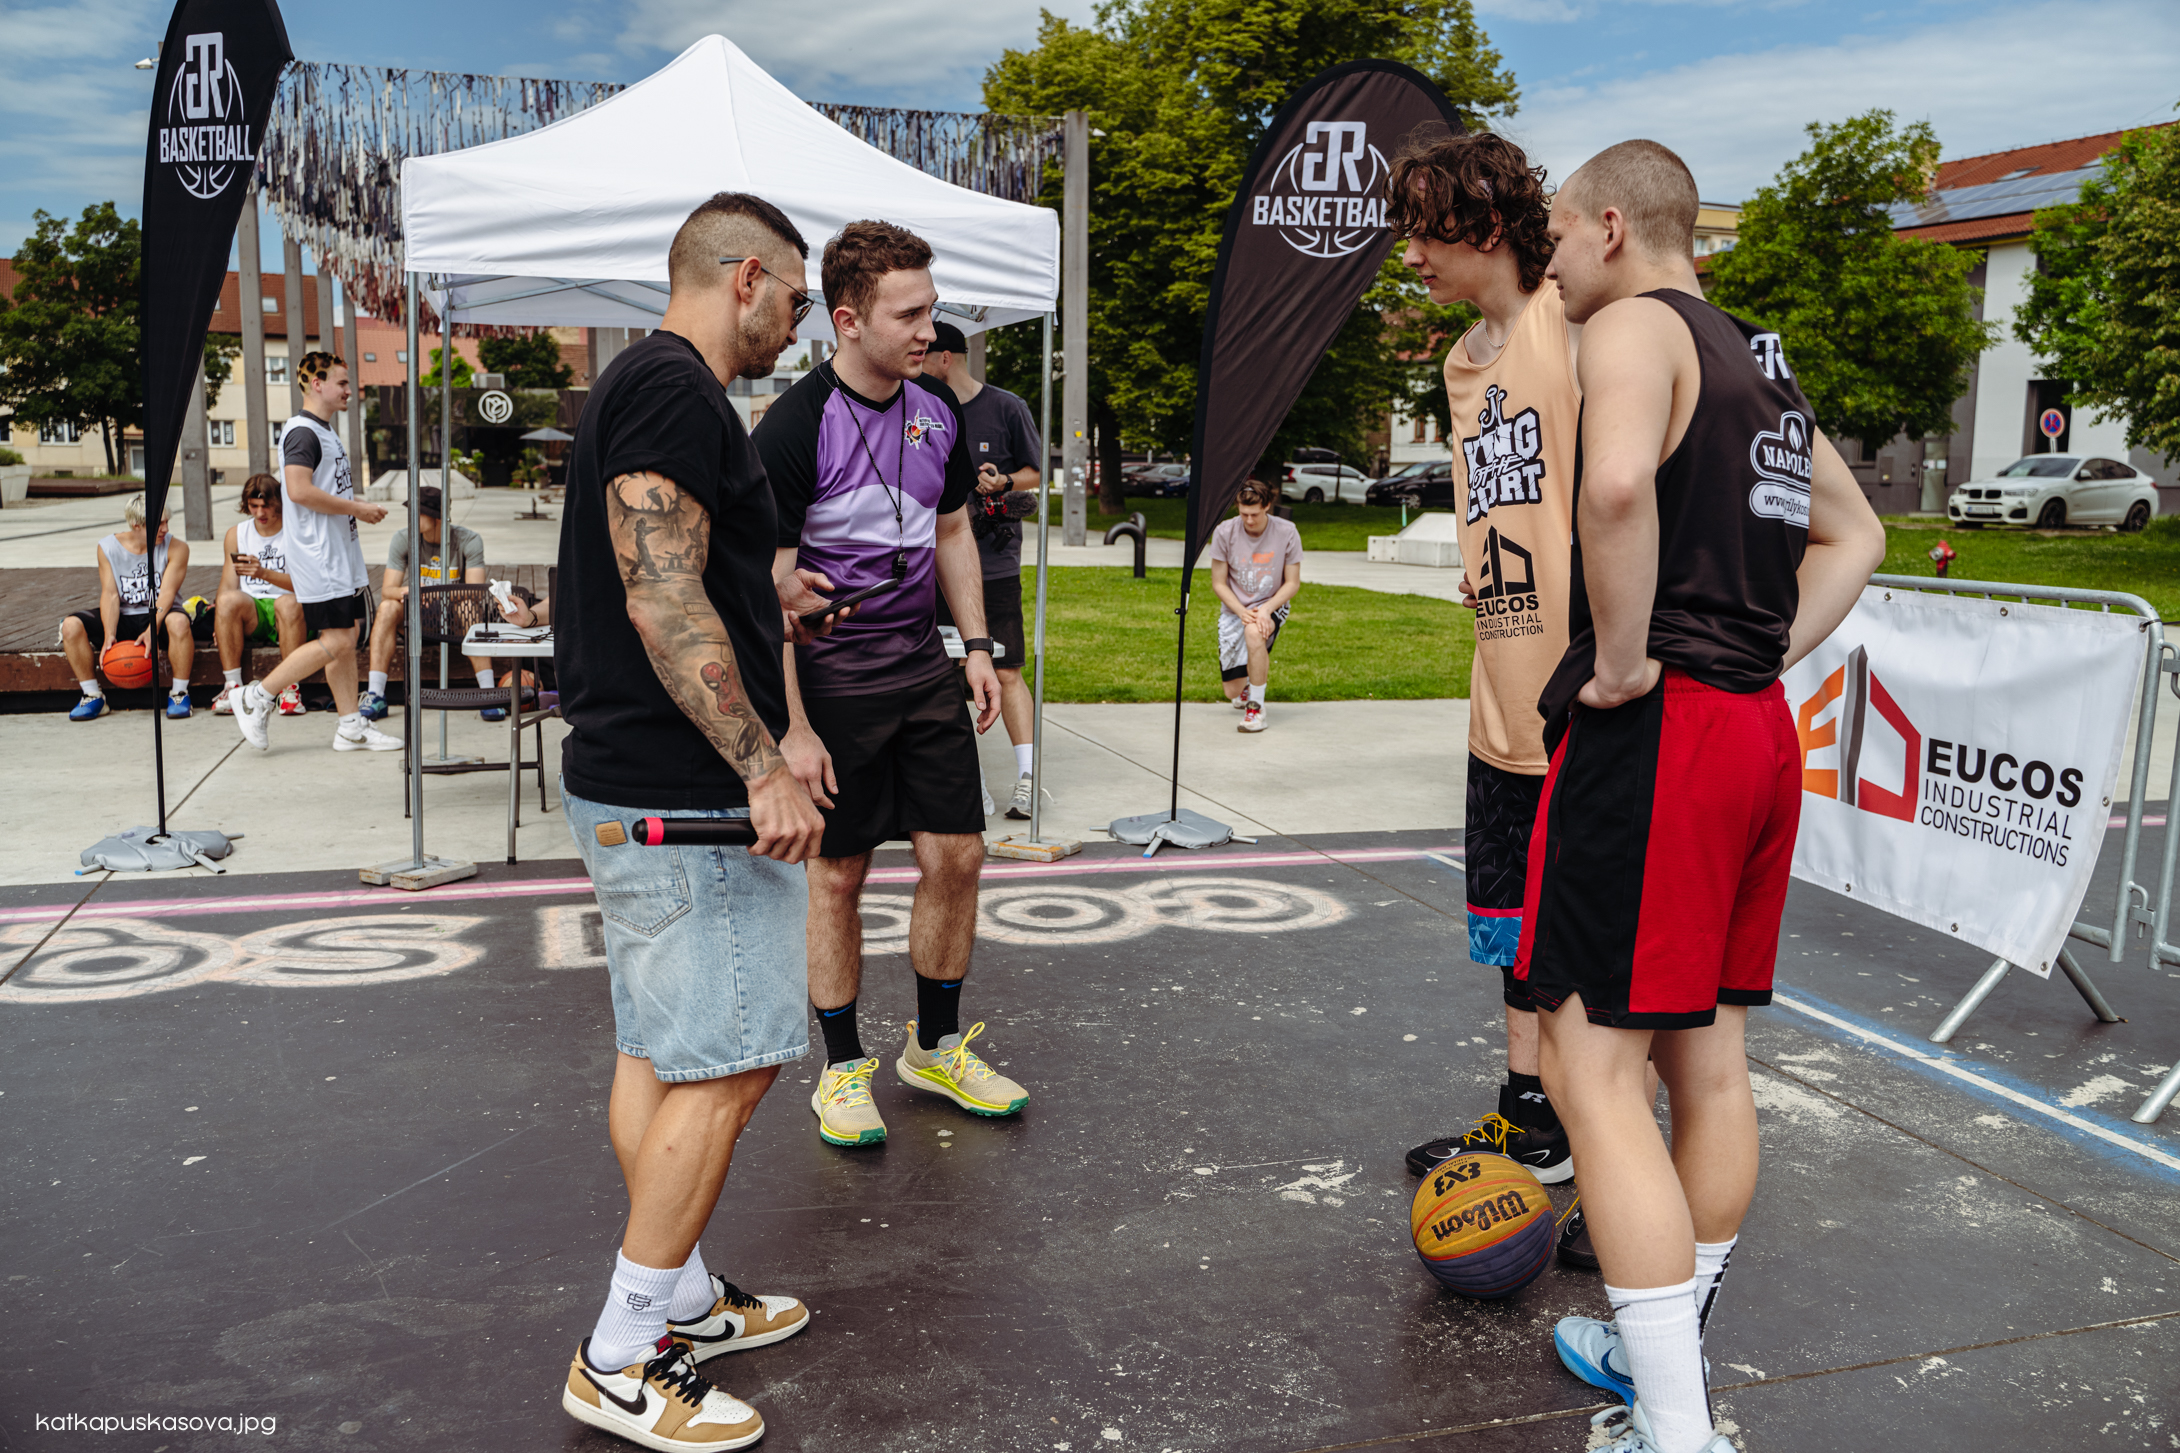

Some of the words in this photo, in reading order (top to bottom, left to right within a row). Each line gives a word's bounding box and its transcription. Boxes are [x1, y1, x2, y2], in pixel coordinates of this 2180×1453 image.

[159, 124, 255, 164] BASKETBALL
[1252, 195, 1393, 229] BASKETBAL
[1476, 594, 1540, 618] EUCOS
[1476, 612, 1542, 631] INDUSTRIAL
[1926, 737, 2084, 808] EUCOS
[1924, 778, 2073, 841] INDUSTRIAL
[1920, 806, 2070, 868] CONSTRUCTIONS
[1430, 1189, 1531, 1242] Wilson
